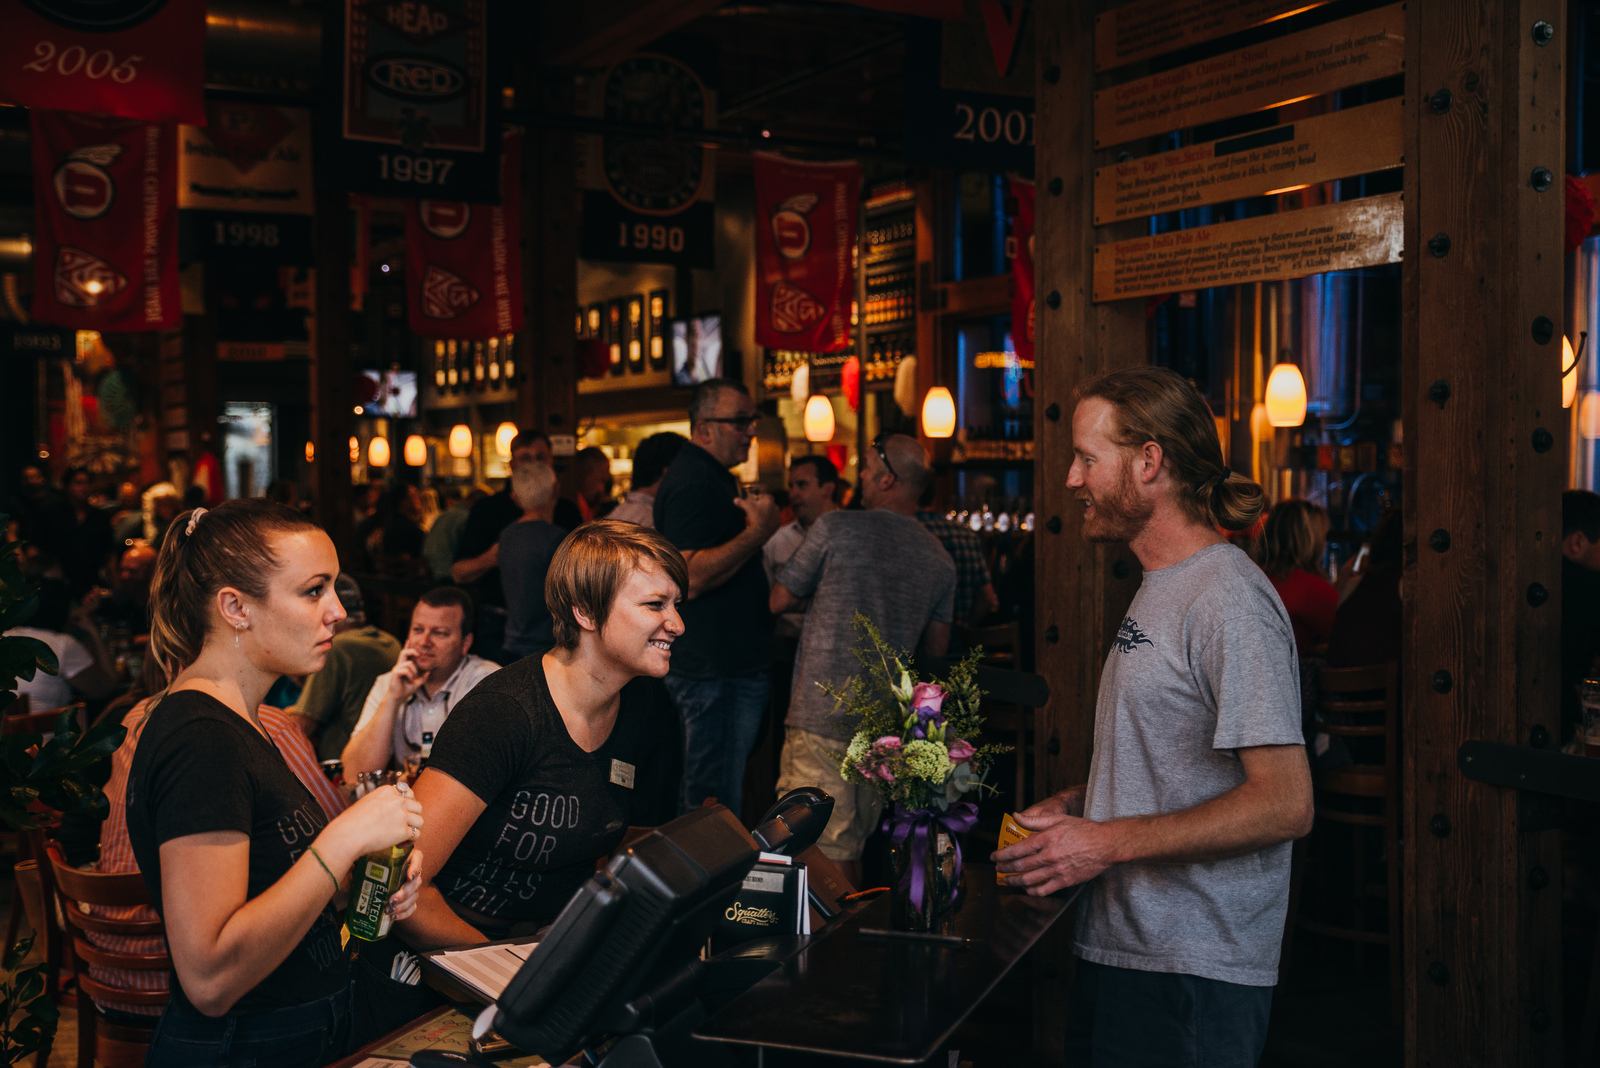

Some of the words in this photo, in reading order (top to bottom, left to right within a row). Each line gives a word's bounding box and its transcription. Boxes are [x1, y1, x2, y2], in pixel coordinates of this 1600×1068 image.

[384, 2, 448, 33] HEAD
[23, 40, 142, 84] 2005
[952, 102, 1036, 146] 2001
[378, 154, 455, 185] 1997
[1249, 150, 1260, 162] the
[1298, 152, 1316, 166] head
[214, 222, 280, 247] 1998
[618, 222, 685, 253] 1990
[1153, 234, 1173, 248] India
[1175, 231, 1192, 245] Pale
[1197, 228, 1209, 241] Ale
[1294, 227, 1307, 237] and
[1217, 249, 1239, 261] English
[1264, 241, 1285, 252] British
[1286, 237, 1312, 248] brewers
[1322, 234, 1334, 243] the
[1262, 253, 1275, 265] long
[1300, 246, 1316, 259] from
[1318, 242, 1346, 255] England
[1305, 256, 1329, 267] Alcohol
[511, 790, 579, 828] GOOD
[494, 822, 556, 865] FOR
[368, 884, 387, 922] ELATED
